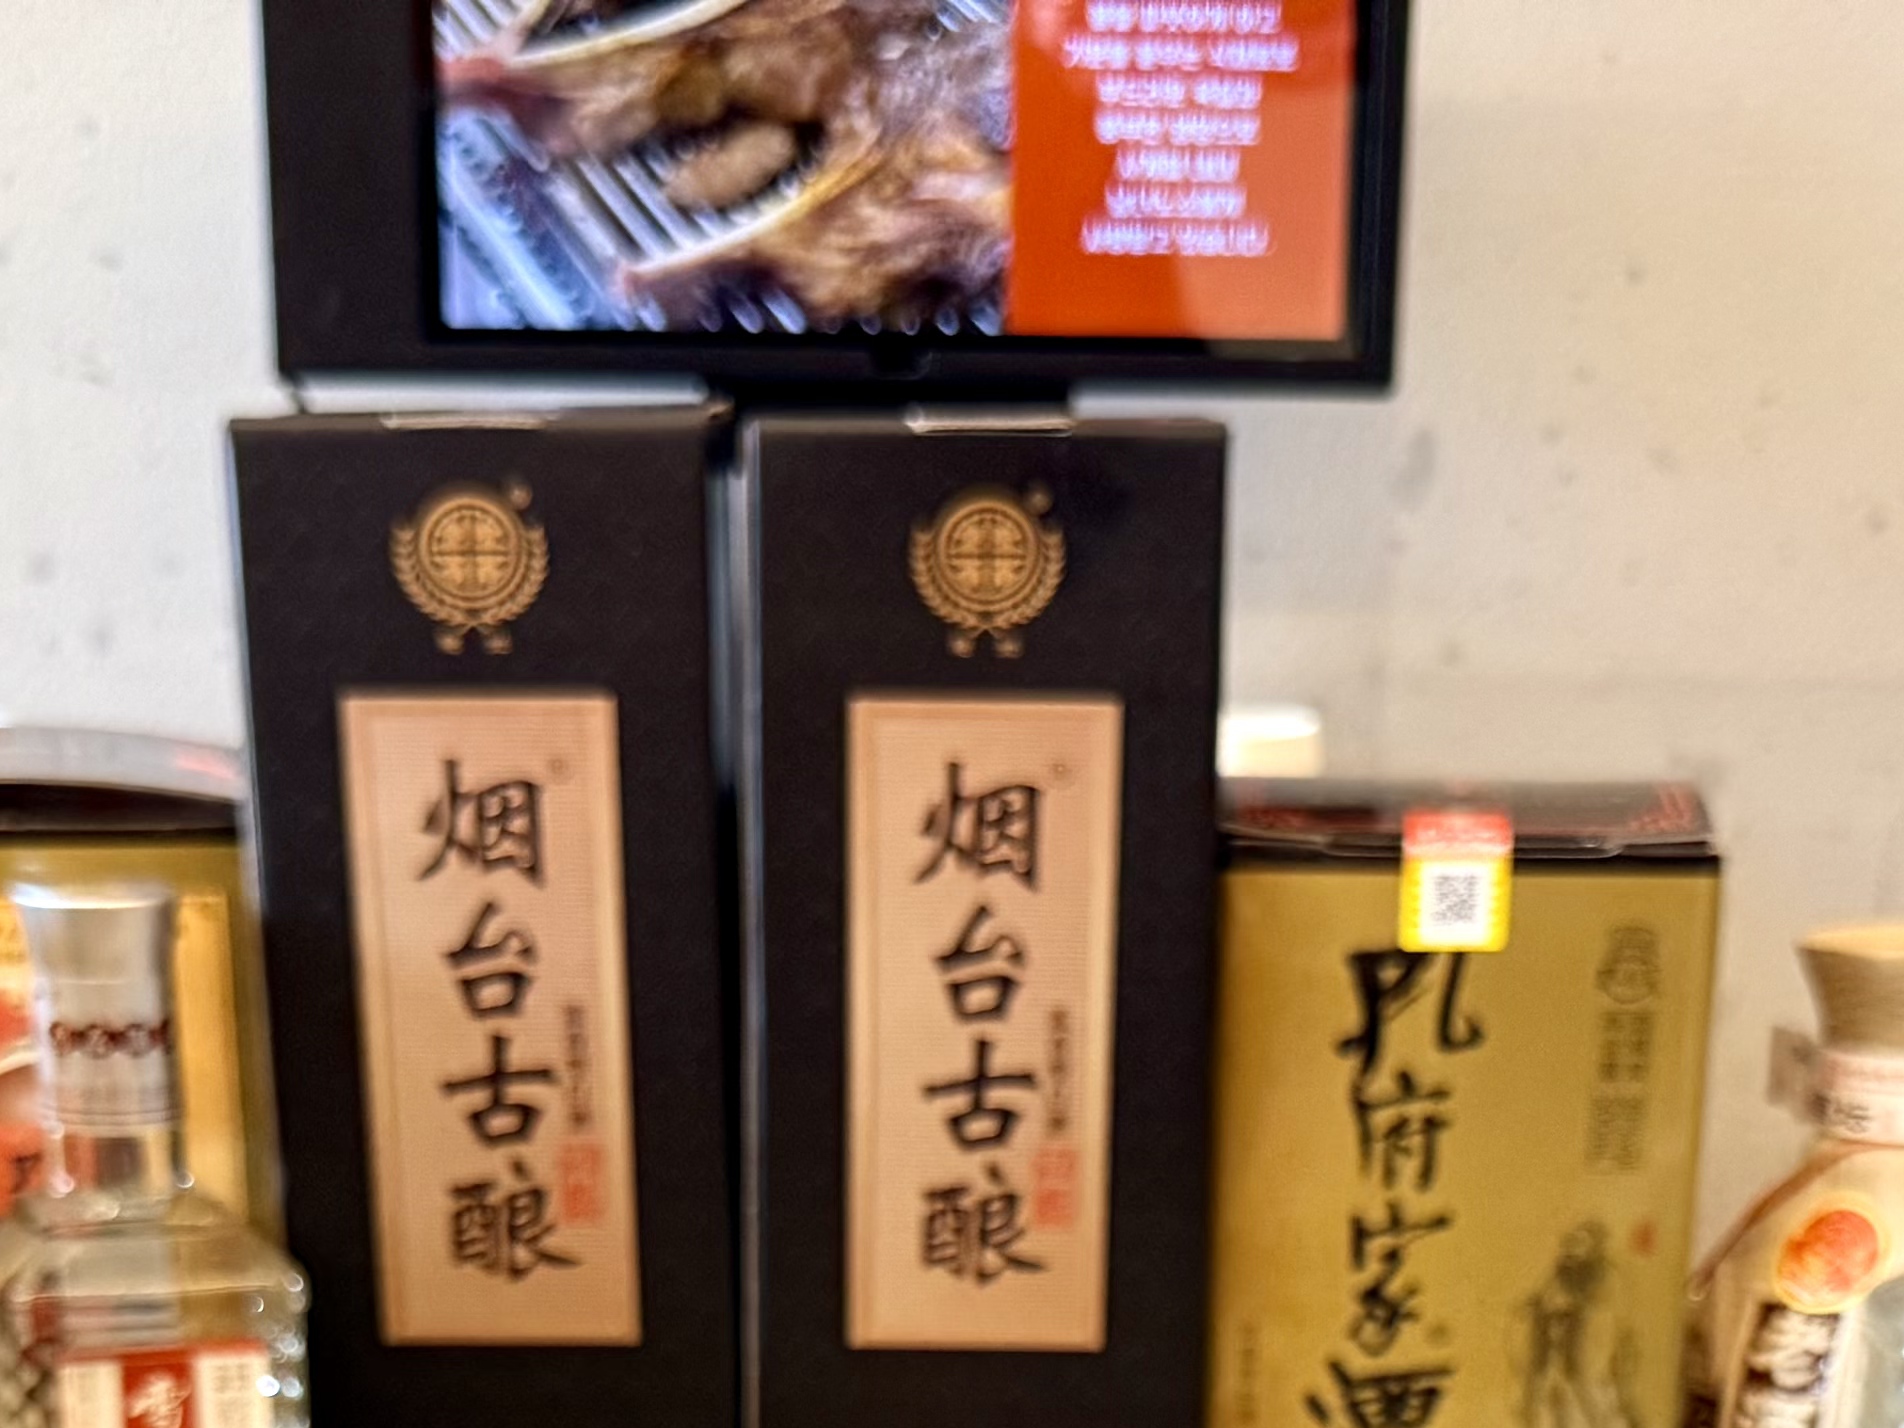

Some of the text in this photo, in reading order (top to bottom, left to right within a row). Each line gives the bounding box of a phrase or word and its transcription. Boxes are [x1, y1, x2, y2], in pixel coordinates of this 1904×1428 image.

[415, 758, 584, 1284] 烟台古酿
[912, 760, 1050, 1286] 烟台古酿
